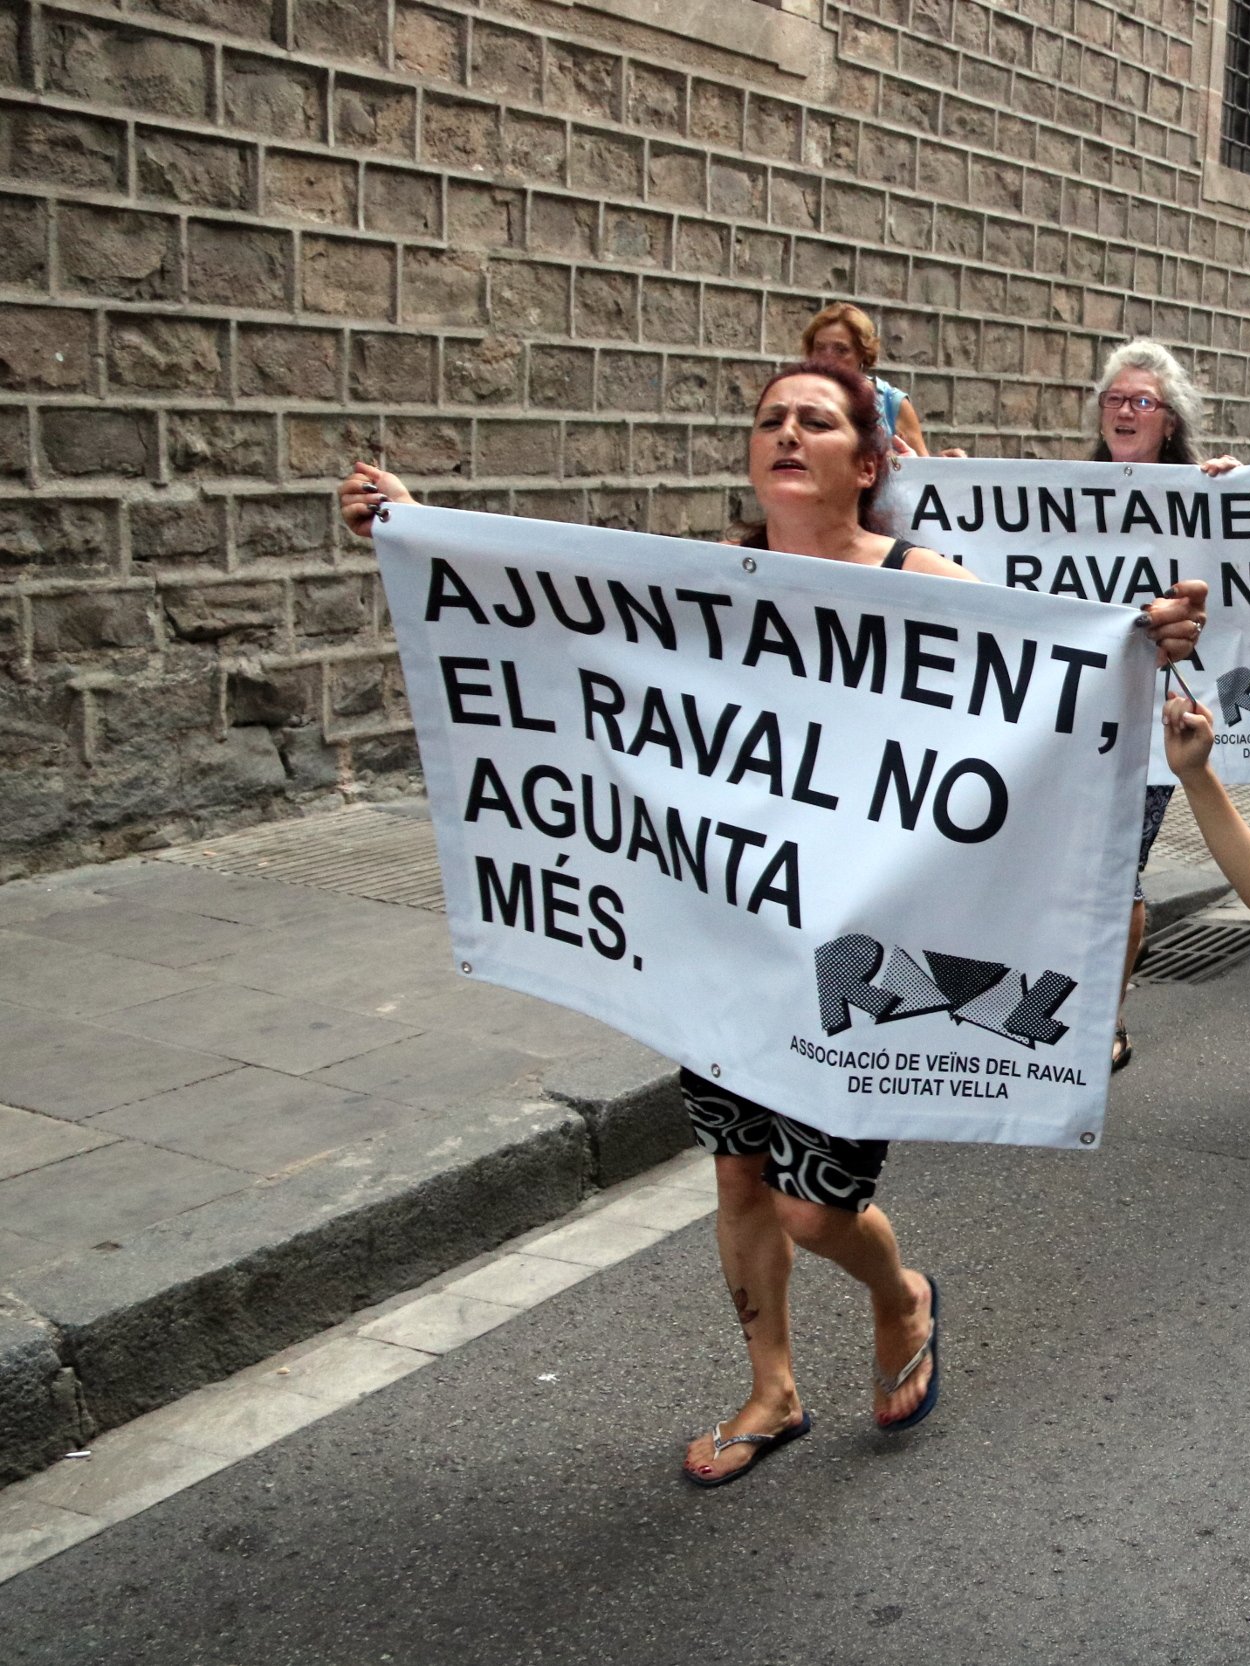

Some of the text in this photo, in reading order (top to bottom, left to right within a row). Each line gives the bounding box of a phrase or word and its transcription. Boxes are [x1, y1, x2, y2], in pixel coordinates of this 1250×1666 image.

[425, 558, 1118, 754] AJUNTAMENT,
[440, 656, 1008, 843] EL RAVAL NO
[465, 757, 801, 928] AGUANTA
[476, 854, 642, 971] MÉS.
[790, 1035, 1087, 1086] ASSOCIACIÓ DE VEÏNS DEL RAVAL
[848, 1075, 1009, 1099] DE CIUTAT VELLA
